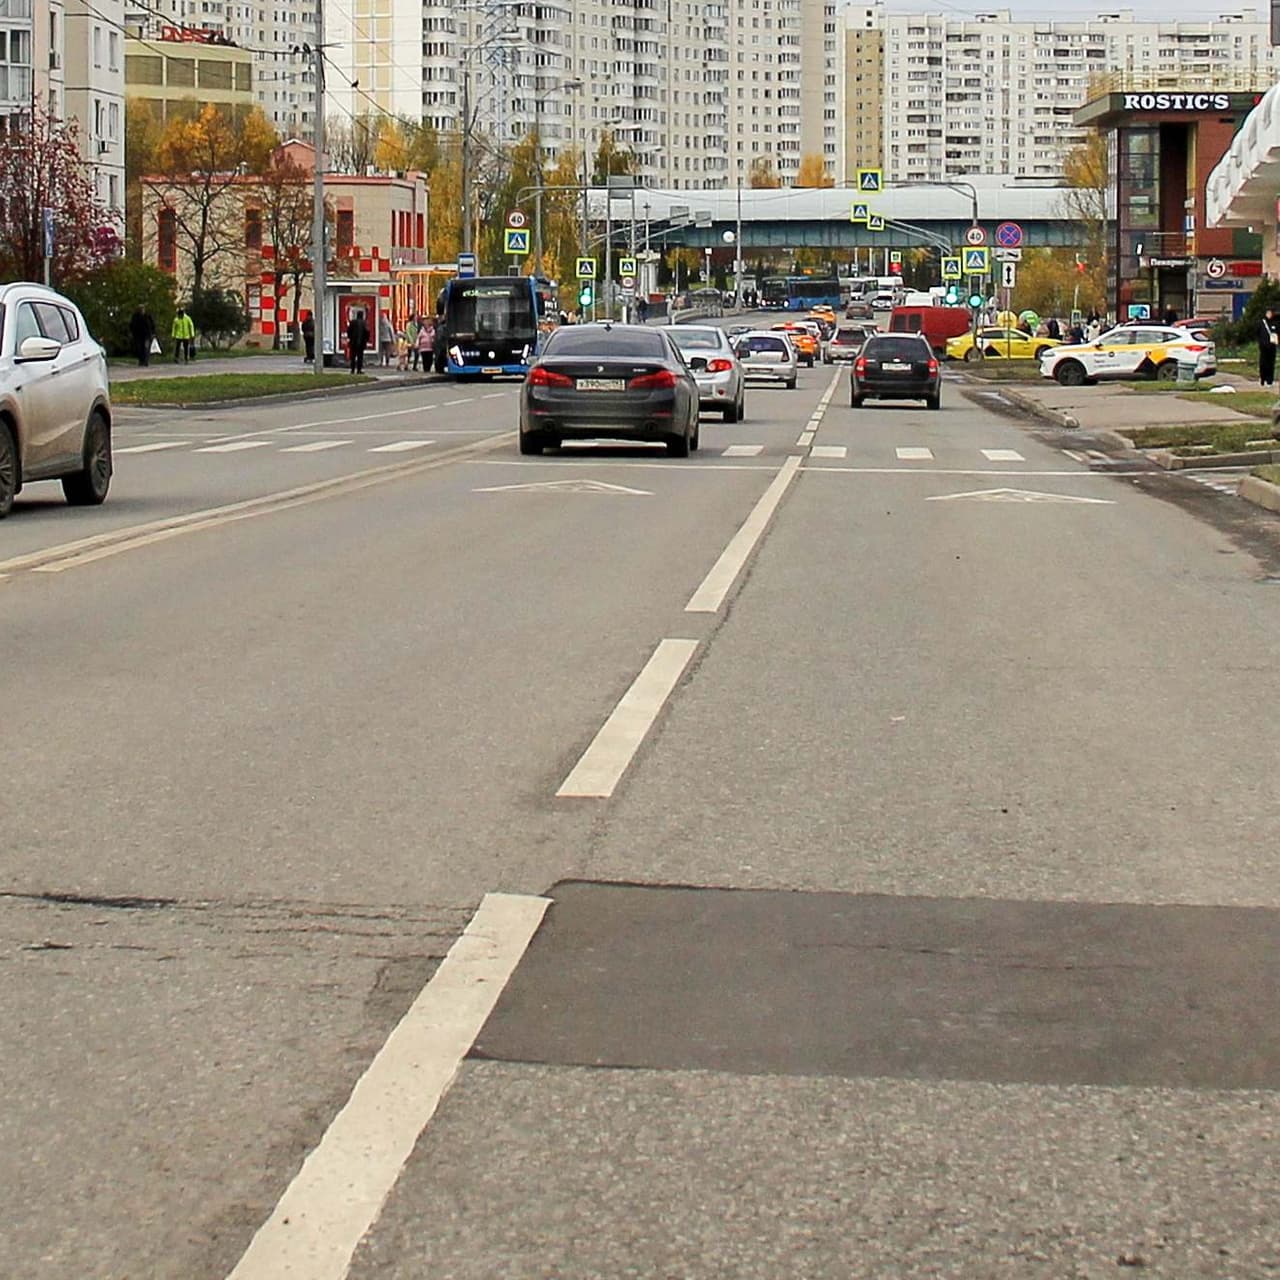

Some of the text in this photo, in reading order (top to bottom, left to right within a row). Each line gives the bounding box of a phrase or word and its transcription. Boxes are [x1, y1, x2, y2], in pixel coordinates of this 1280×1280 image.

[1124, 94, 1229, 110] ROSTIC'S
[511, 215, 522, 224] 40
[969, 232, 982, 240] 40
